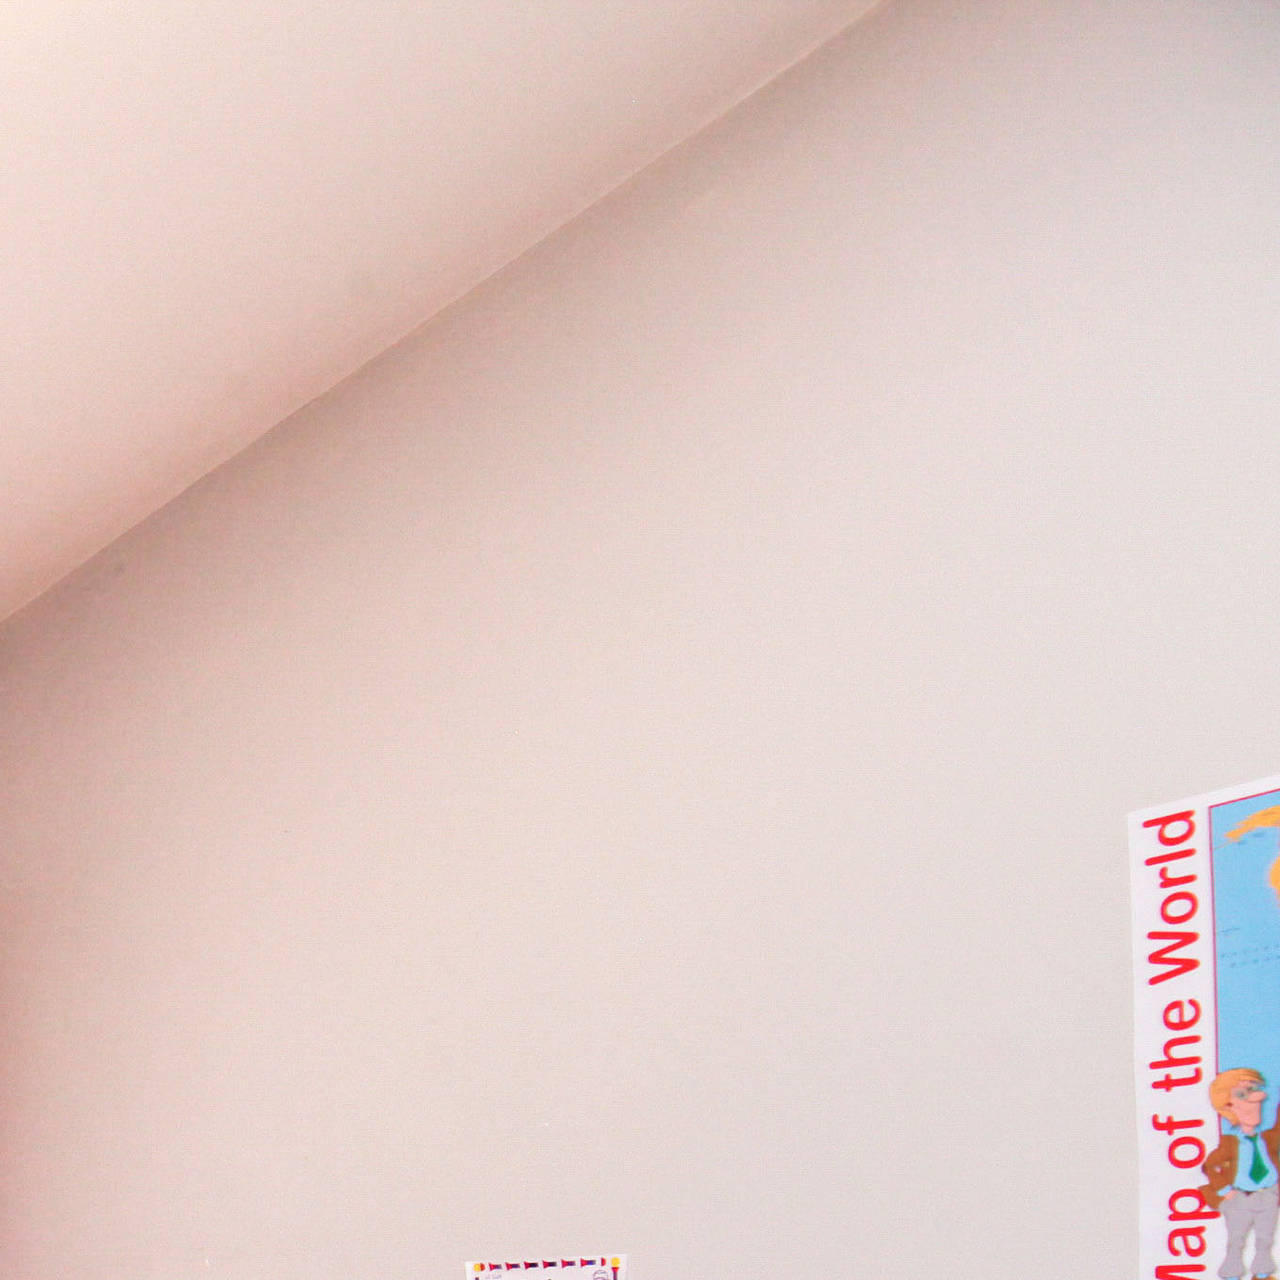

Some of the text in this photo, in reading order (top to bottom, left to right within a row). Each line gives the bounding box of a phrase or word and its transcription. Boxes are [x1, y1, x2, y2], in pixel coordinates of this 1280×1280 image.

[1142, 809, 1201, 986] World
[1149, 997, 1203, 1093] the
[1152, 1113, 1207, 1169] of
